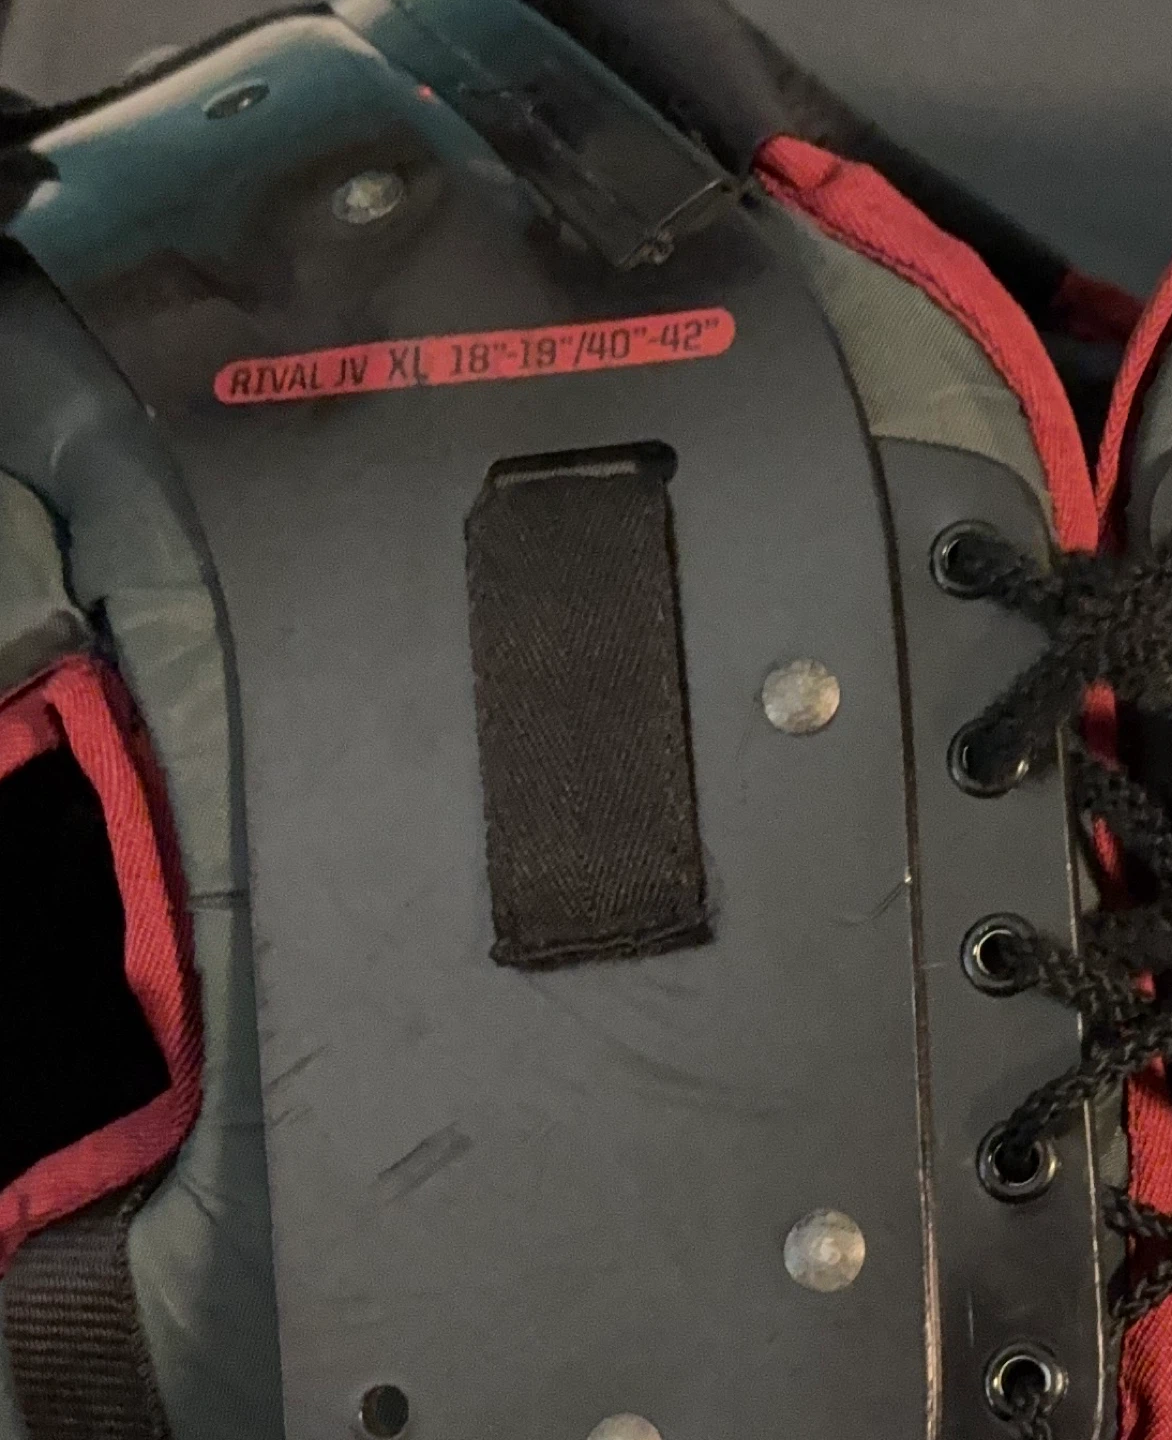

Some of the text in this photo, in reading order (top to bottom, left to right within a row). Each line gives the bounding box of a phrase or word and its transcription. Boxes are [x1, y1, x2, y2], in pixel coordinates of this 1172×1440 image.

[228, 364, 322, 397] RIVAL
[334, 356, 370, 389] JV
[386, 347, 429, 382] XL
